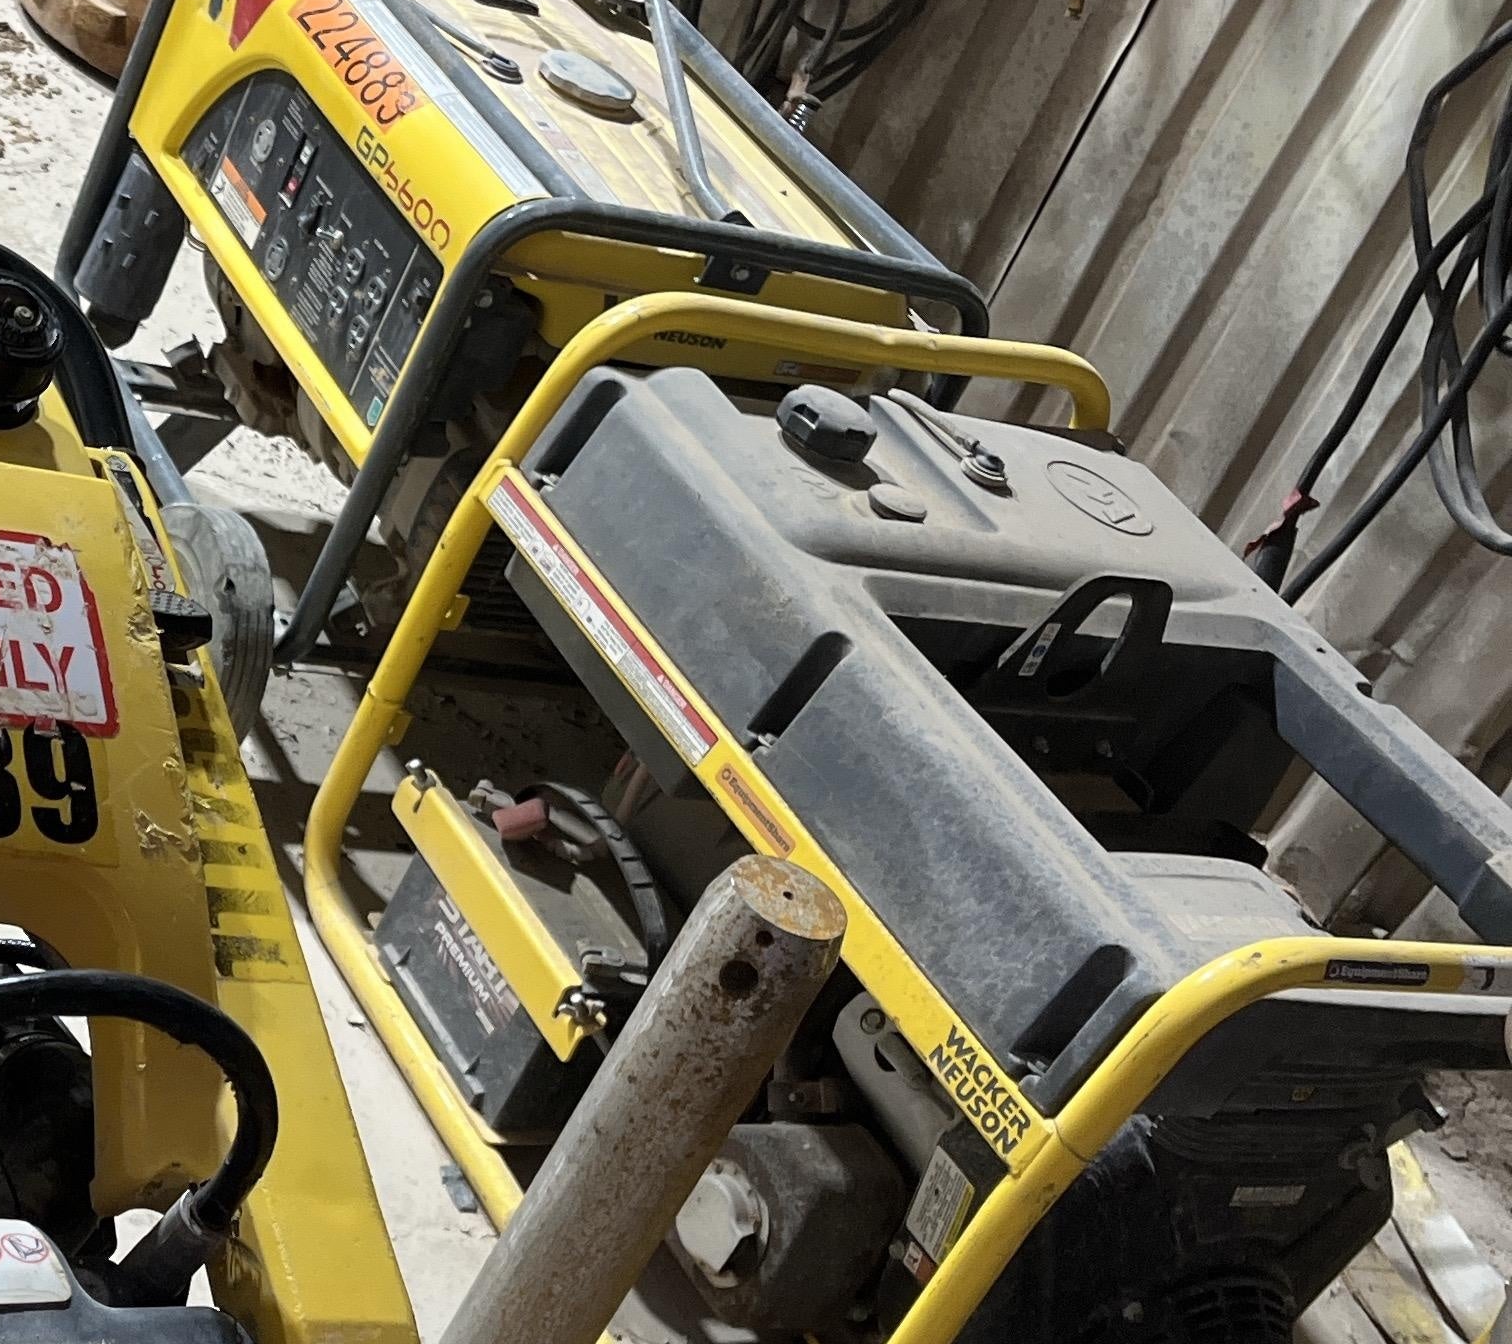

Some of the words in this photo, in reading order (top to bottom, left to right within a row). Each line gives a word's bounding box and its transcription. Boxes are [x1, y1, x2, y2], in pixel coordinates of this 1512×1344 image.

[653, 330, 729, 350] NEUSON
[434, 919, 491, 1003] PREMIUM
[928, 1043, 1019, 1155] NEUSON
[945, 1024, 1032, 1140] WACKER
